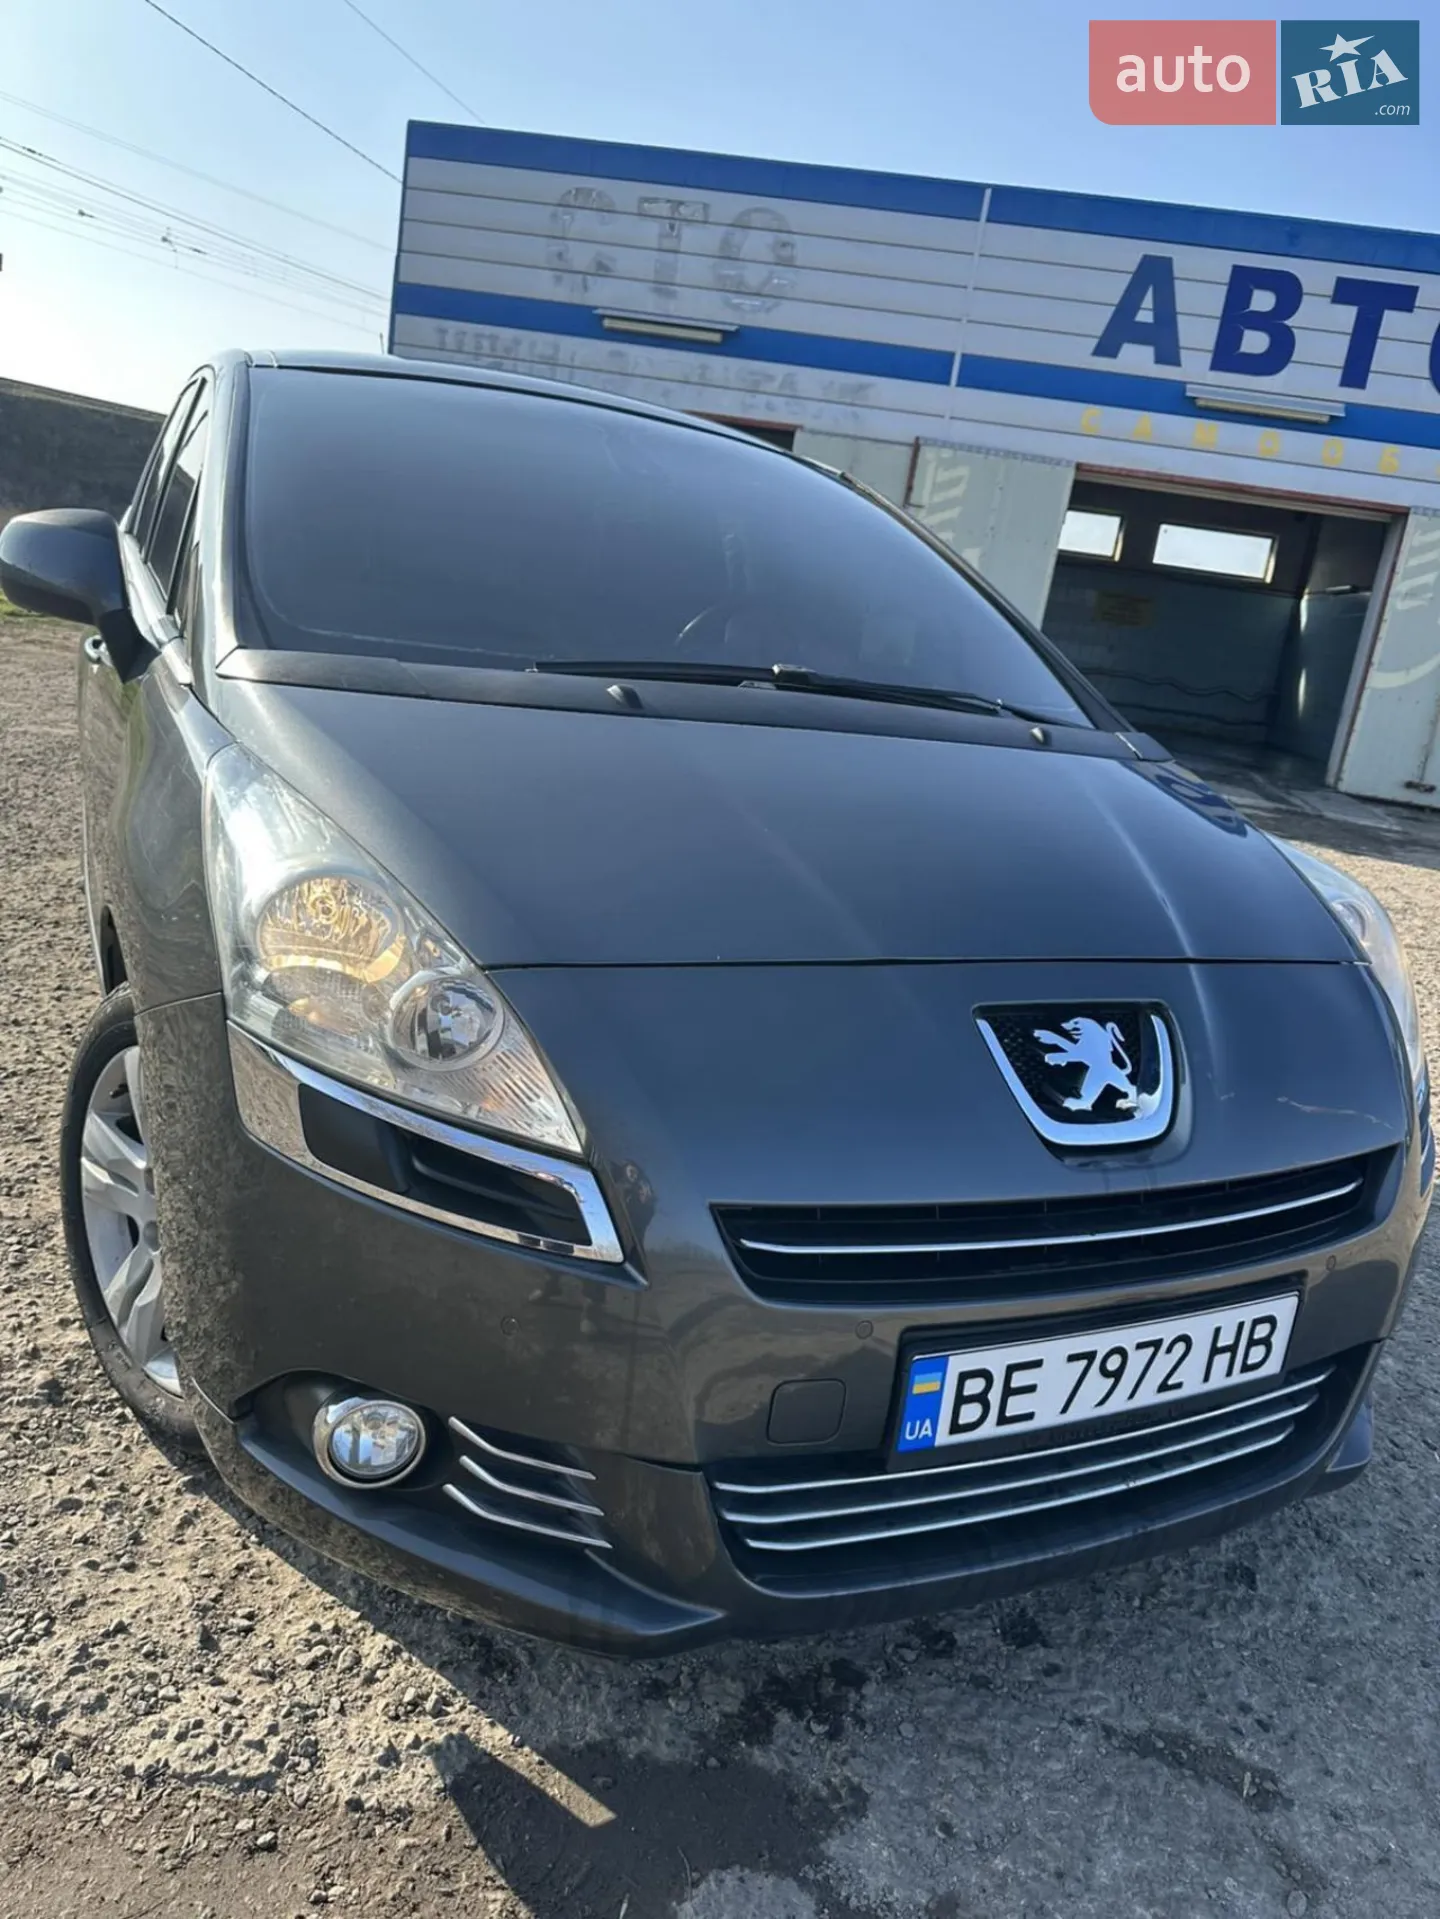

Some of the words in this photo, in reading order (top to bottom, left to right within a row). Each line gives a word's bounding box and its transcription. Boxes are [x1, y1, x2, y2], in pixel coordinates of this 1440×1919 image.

[1091, 254, 1440, 394] АВТ
[1080, 409, 1440, 476] САМООБ
[948, 1358, 1044, 1436] BE
[1058, 1333, 1194, 1415] 7972
[1202, 1314, 1279, 1384] HB
[904, 1418, 933, 1441] UA
